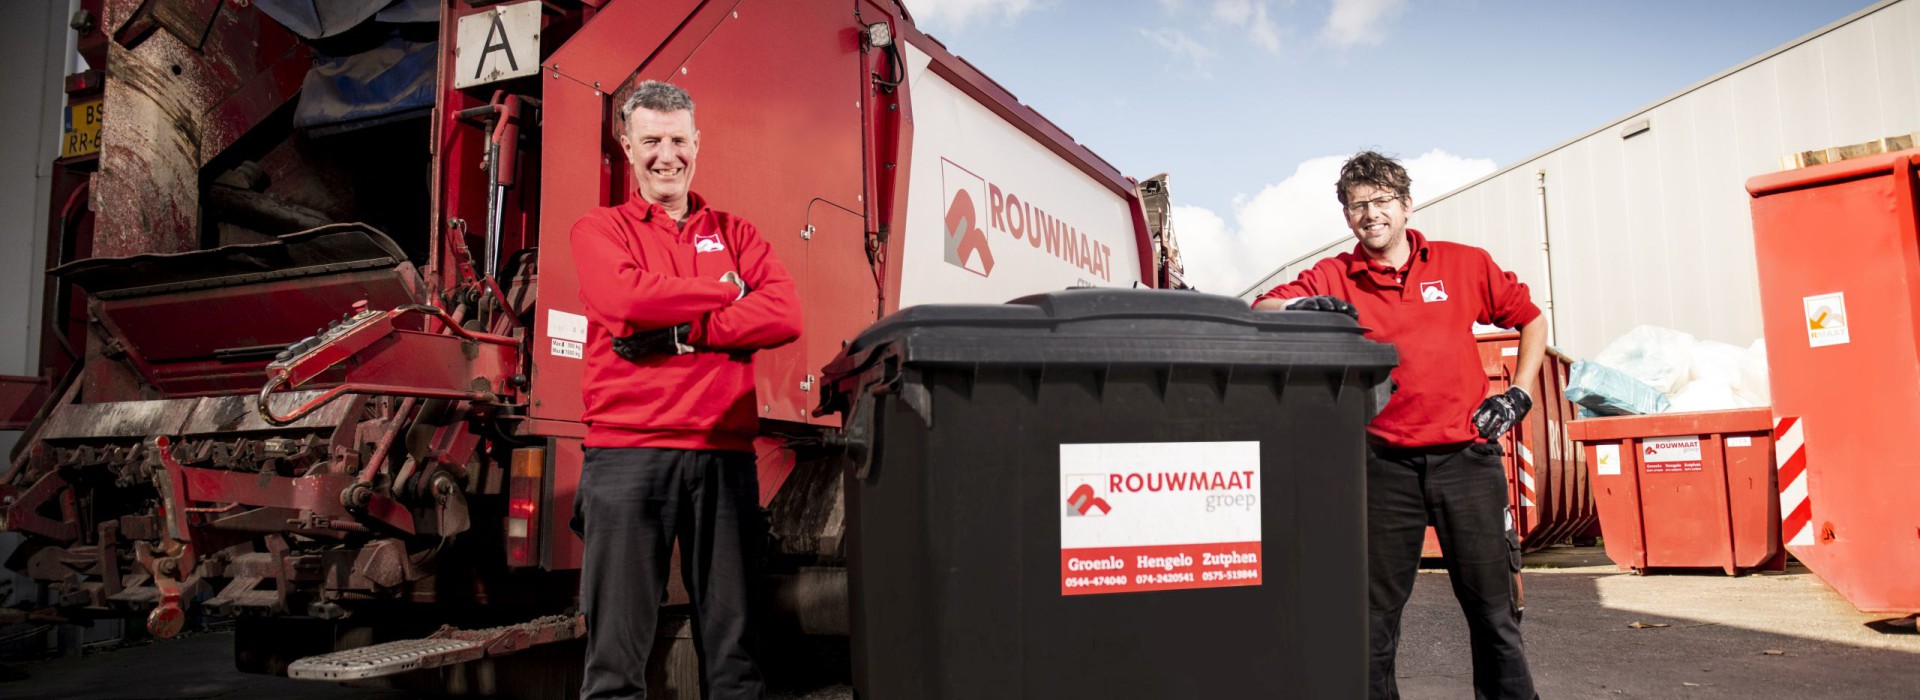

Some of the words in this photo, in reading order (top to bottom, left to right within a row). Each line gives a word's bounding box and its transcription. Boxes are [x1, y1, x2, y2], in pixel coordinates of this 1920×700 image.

[474, 9, 519, 80] A
[988, 181, 1111, 283] ROUWMAAT
[1655, 441, 1698, 450] ROUWMAAT
[1109, 471, 1254, 493] ROUWMAAT
[1205, 492, 1256, 513] groep
[1068, 556, 1125, 571] Groenlo
[1136, 553, 1194, 571] Hengelo
[1202, 550, 1258, 569] Zutphen
[1065, 575, 1128, 588] 0544-474040
